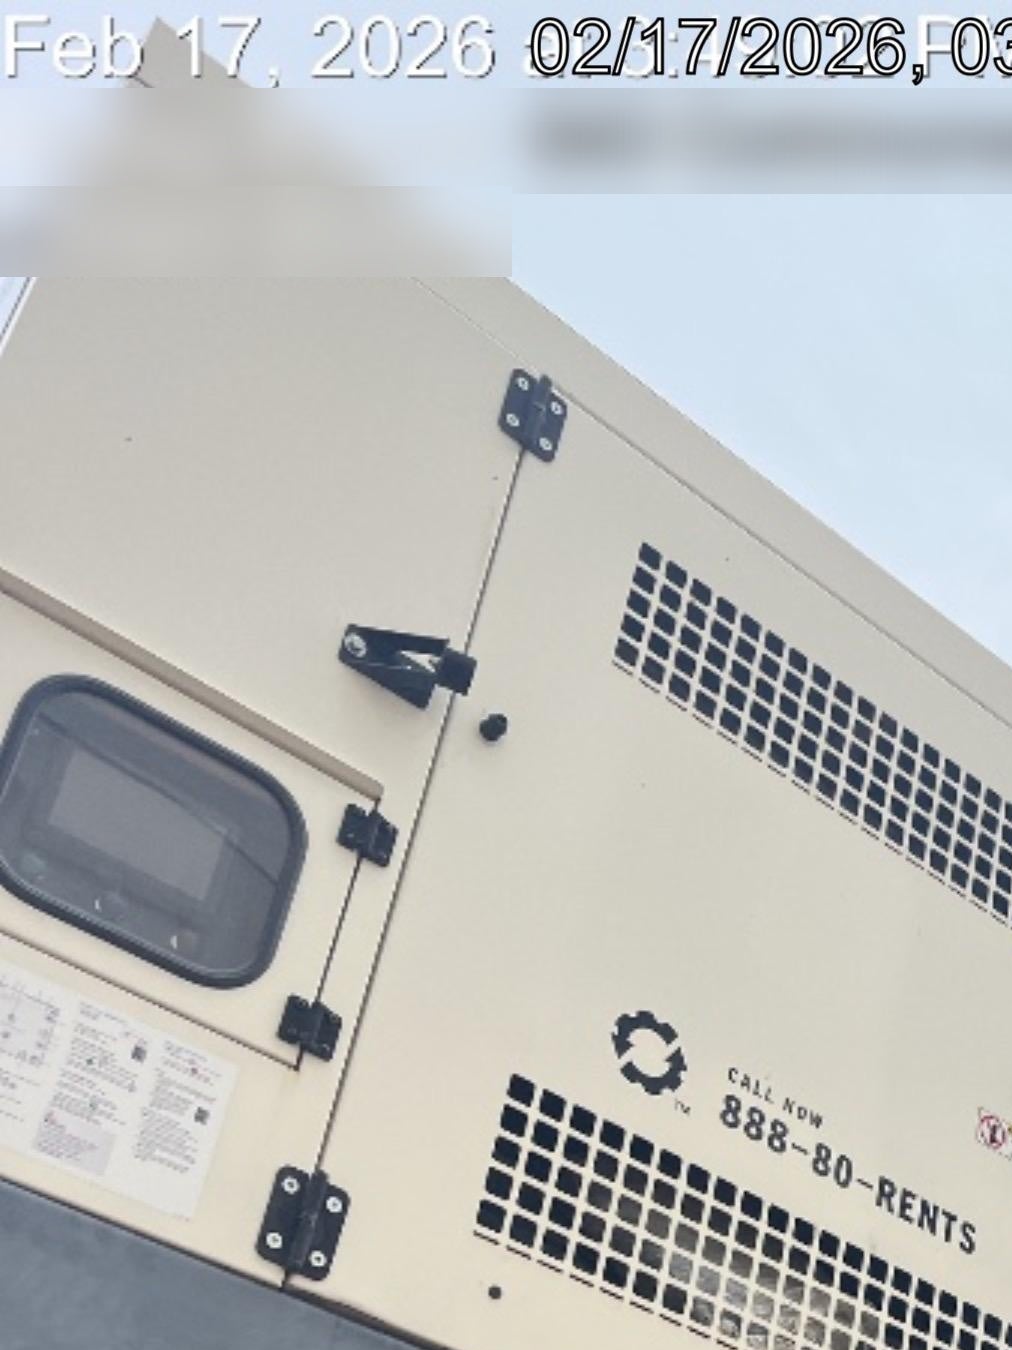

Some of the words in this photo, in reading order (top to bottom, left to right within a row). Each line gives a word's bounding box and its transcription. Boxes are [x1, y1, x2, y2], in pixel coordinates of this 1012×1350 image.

[728, 1067, 774, 1104] CALL
[782, 1097, 824, 1129] NOW
[719, 1094, 977, 1255] 888-80-RENTS
